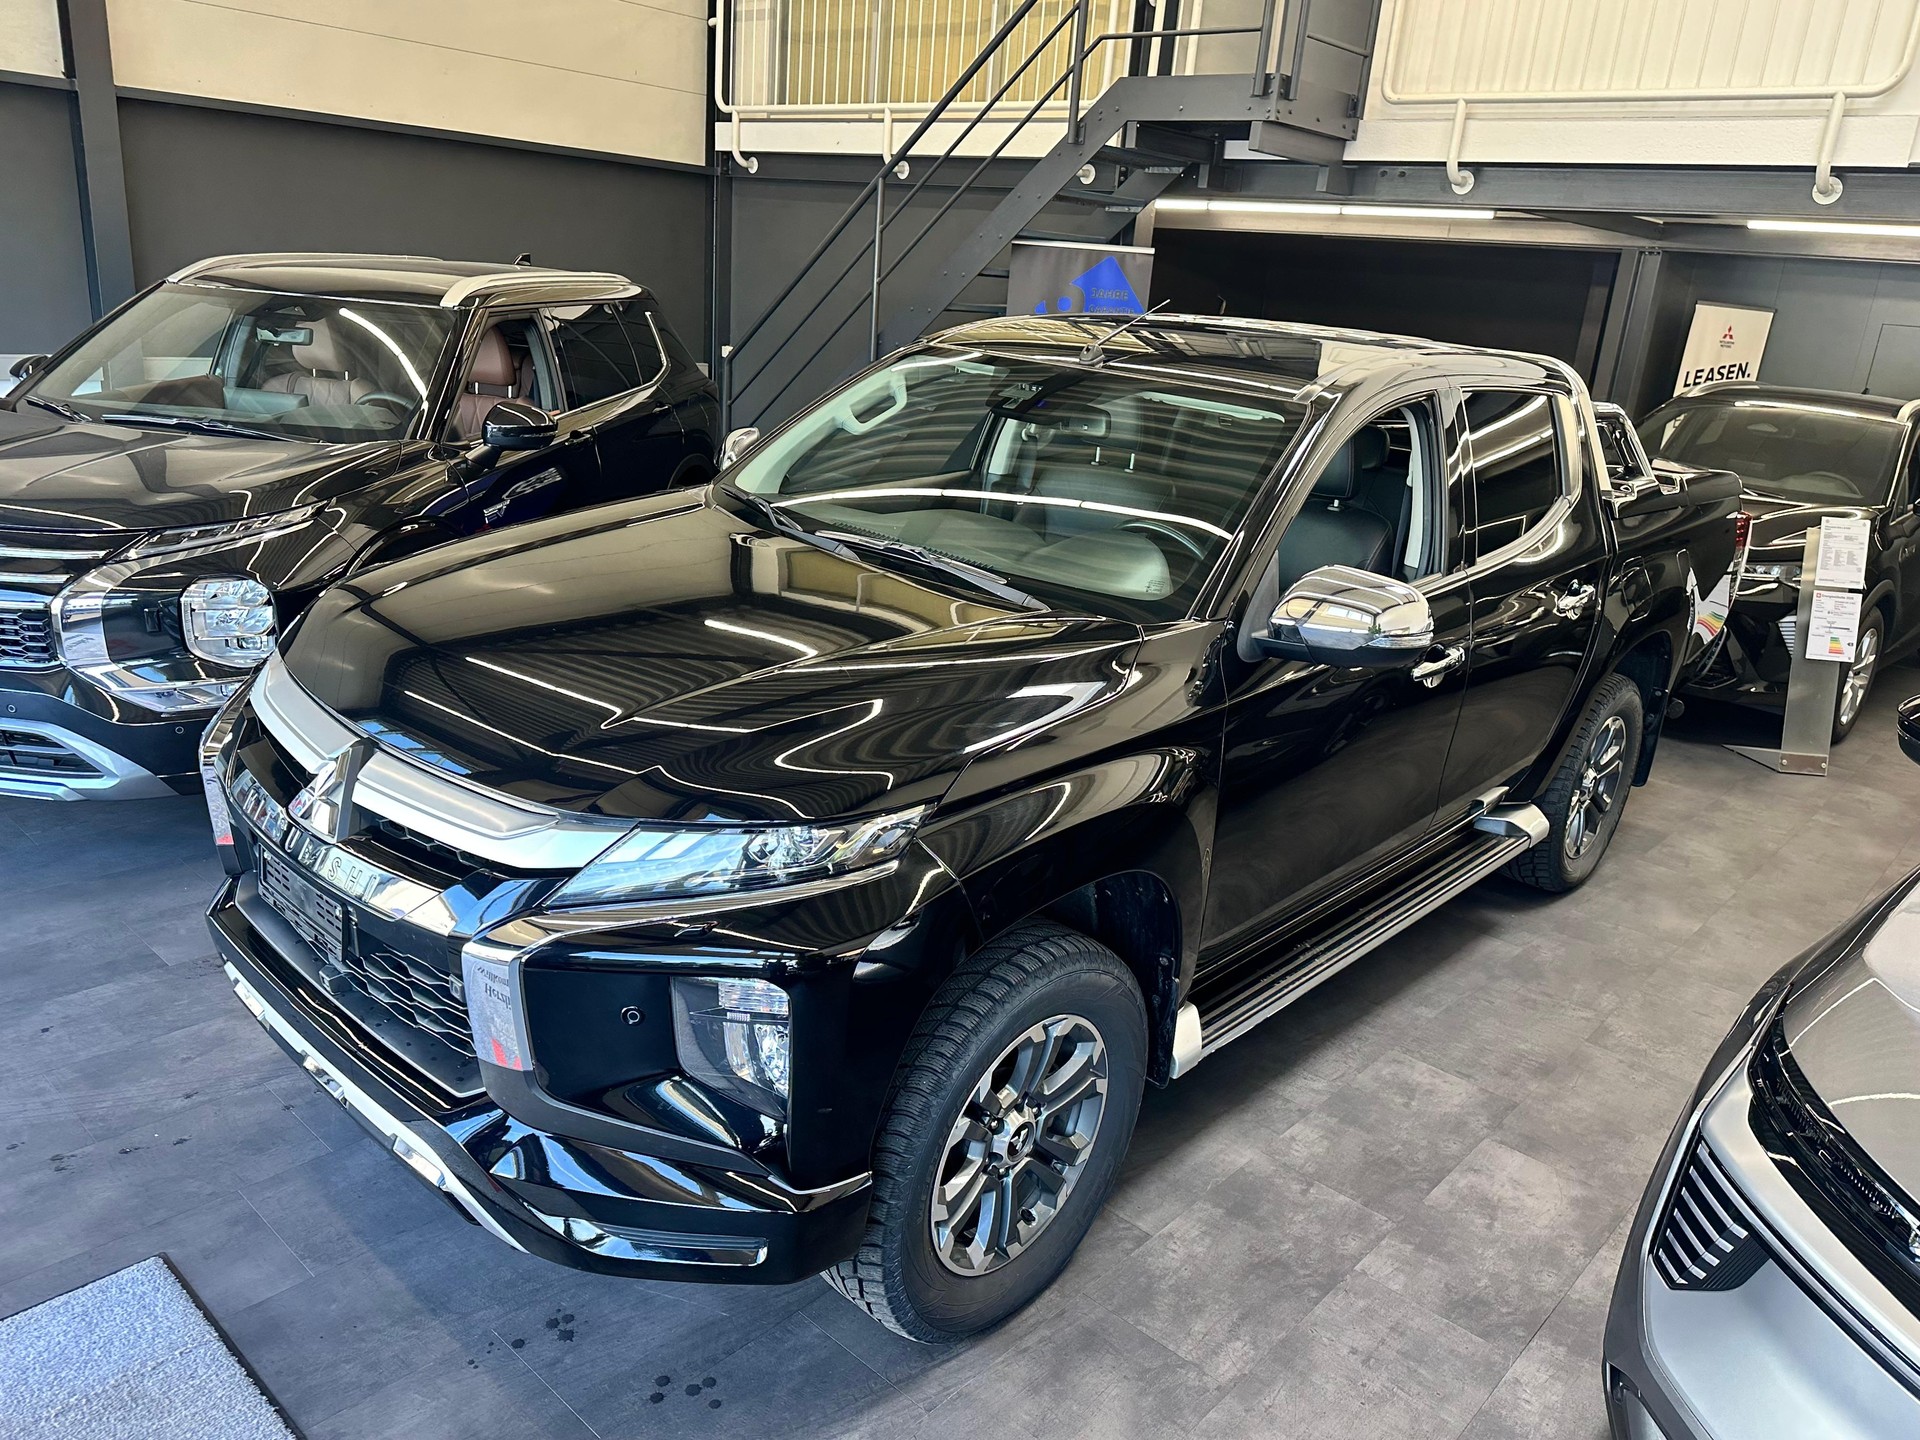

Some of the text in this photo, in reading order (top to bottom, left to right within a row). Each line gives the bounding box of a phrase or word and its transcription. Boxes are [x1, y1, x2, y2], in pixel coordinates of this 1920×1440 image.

[1091, 288, 1130, 302] JAHRE
[1683, 362, 1751, 388] LEASEN.
[243, 787, 381, 904] MITSUBISHI
